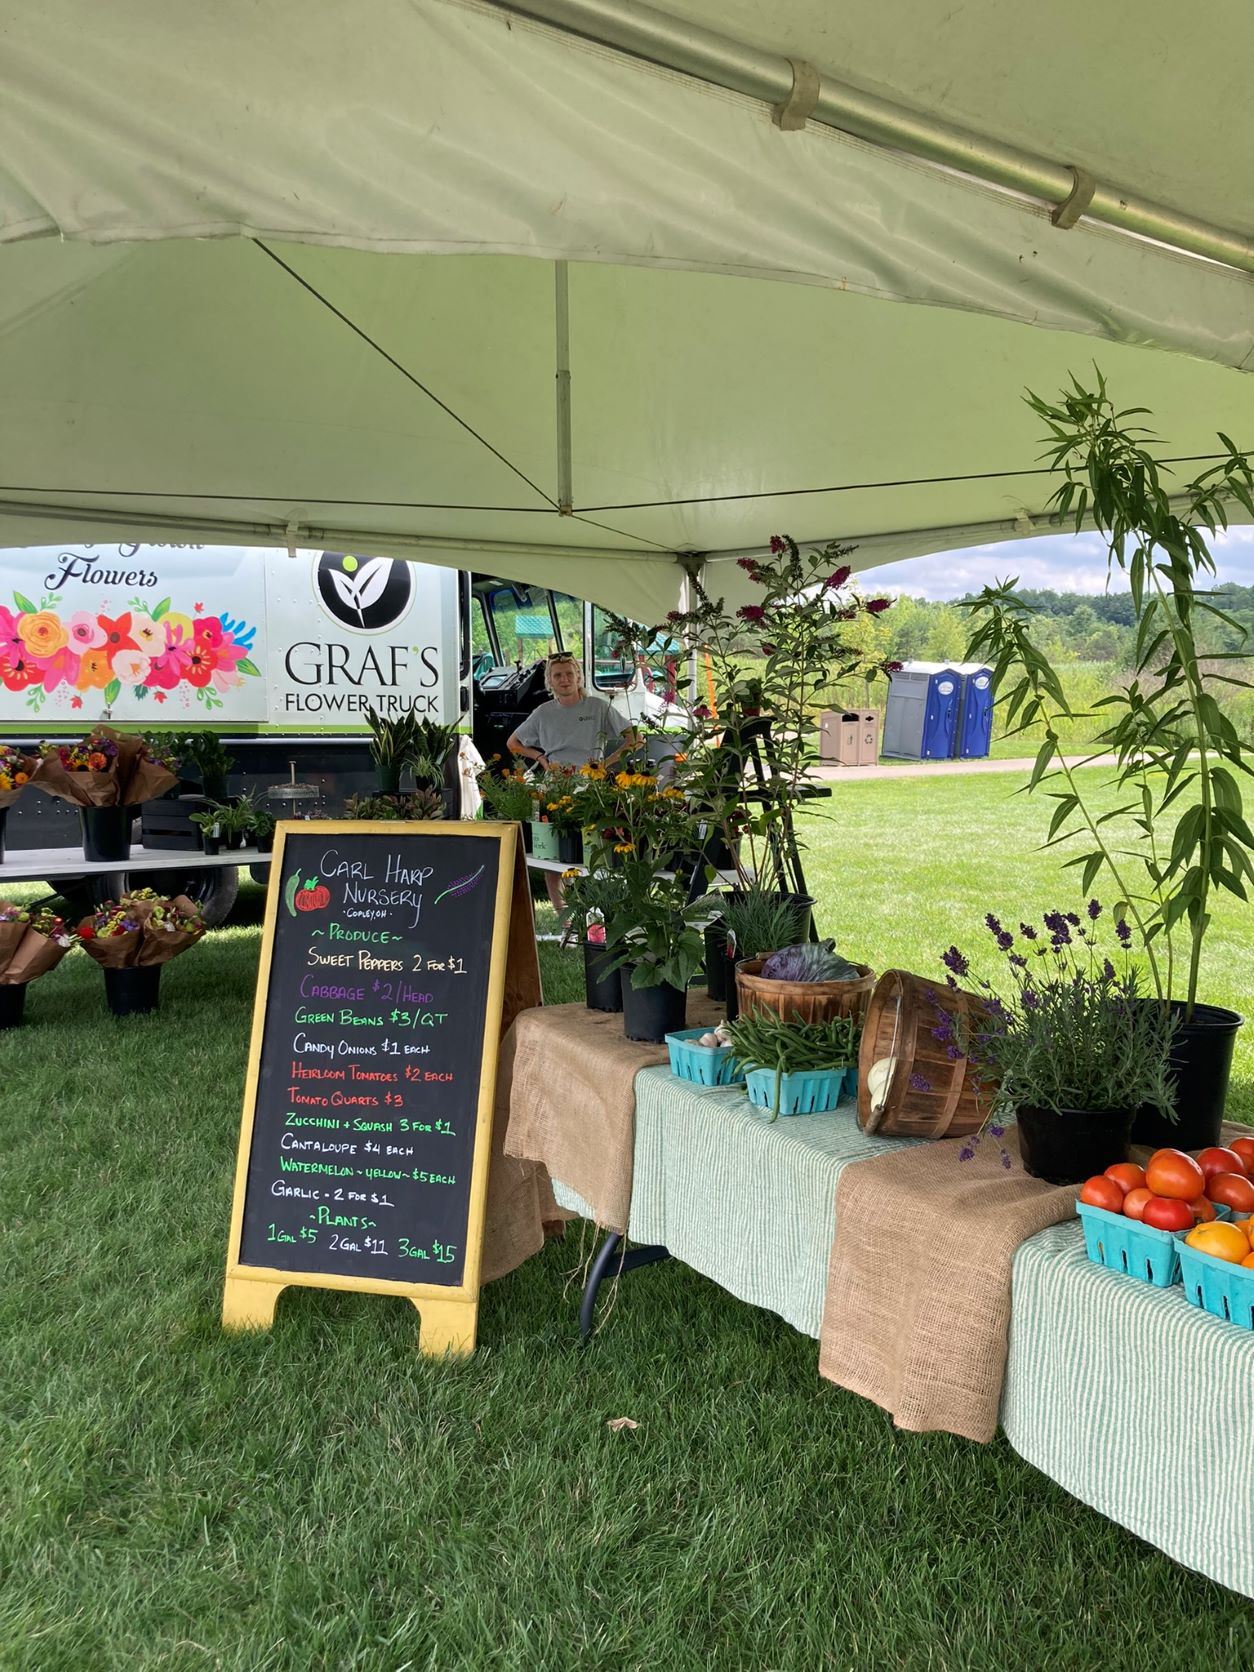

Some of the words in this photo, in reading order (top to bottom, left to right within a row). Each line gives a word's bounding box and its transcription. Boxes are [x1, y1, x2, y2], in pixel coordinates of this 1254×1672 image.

[44, 552, 158, 590] Flowers
[285, 642, 439, 688] GRAF'S
[285, 693, 370, 712] FLOWER
[376, 695, 439, 713] TRUCK
[320, 850, 374, 880] CARL
[385, 854, 433, 886] HARP
[343, 884, 423, 928] NURSERY
[307, 946, 354, 967] SWEET
[358, 950, 403, 971] PEPPERS
[412, 954, 422, 971] 2
[427, 960, 445, 971] FOR
[448, 956, 467, 974] $1
[300, 974, 364, 1000] CABBAGE
[295, 1006, 334, 1024] GREEN
[339, 1009, 383, 1026] BEANS
[293, 1032, 334, 1059] CANDY
[338, 1040, 377, 1055] ONIONS
[381, 1038, 401, 1055] $1
[404, 1045, 430, 1054] EACH
[292, 1061, 345, 1080] HEIRLOOM
[348, 1064, 398, 1082] TOMATOES
[405, 1064, 421, 1081] $2
[424, 1072, 453, 1081] EACH
[288, 1087, 328, 1106] TOMATO
[331, 1091, 379, 1106] QUARTS
[384, 1091, 403, 1107] $3
[285, 1112, 339, 1128] ZUCCHINI
[353, 1118, 392, 1132] SQUASH
[400, 1118, 409, 1131] 3
[412, 1122, 432, 1132] FOR
[435, 1118, 456, 1136] $1
[281, 1133, 357, 1154] CANTALOUPE
[364, 1140, 380, 1155] $4
[386, 1146, 413, 1156] EACH
[280, 1156, 354, 1176] WATERMELON
[413, 1168, 428, 1182] $5
[429, 1174, 455, 1184] EACH
[271, 1180, 319, 1200] GARLIC
[334, 1188, 344, 1200] 2
[348, 1192, 366, 1201] FOR
[371, 1192, 395, 1207] $1
[299, 1226, 318, 1243] $5
[364, 1236, 388, 1255] $11
[432, 1239, 457, 1263] $15
